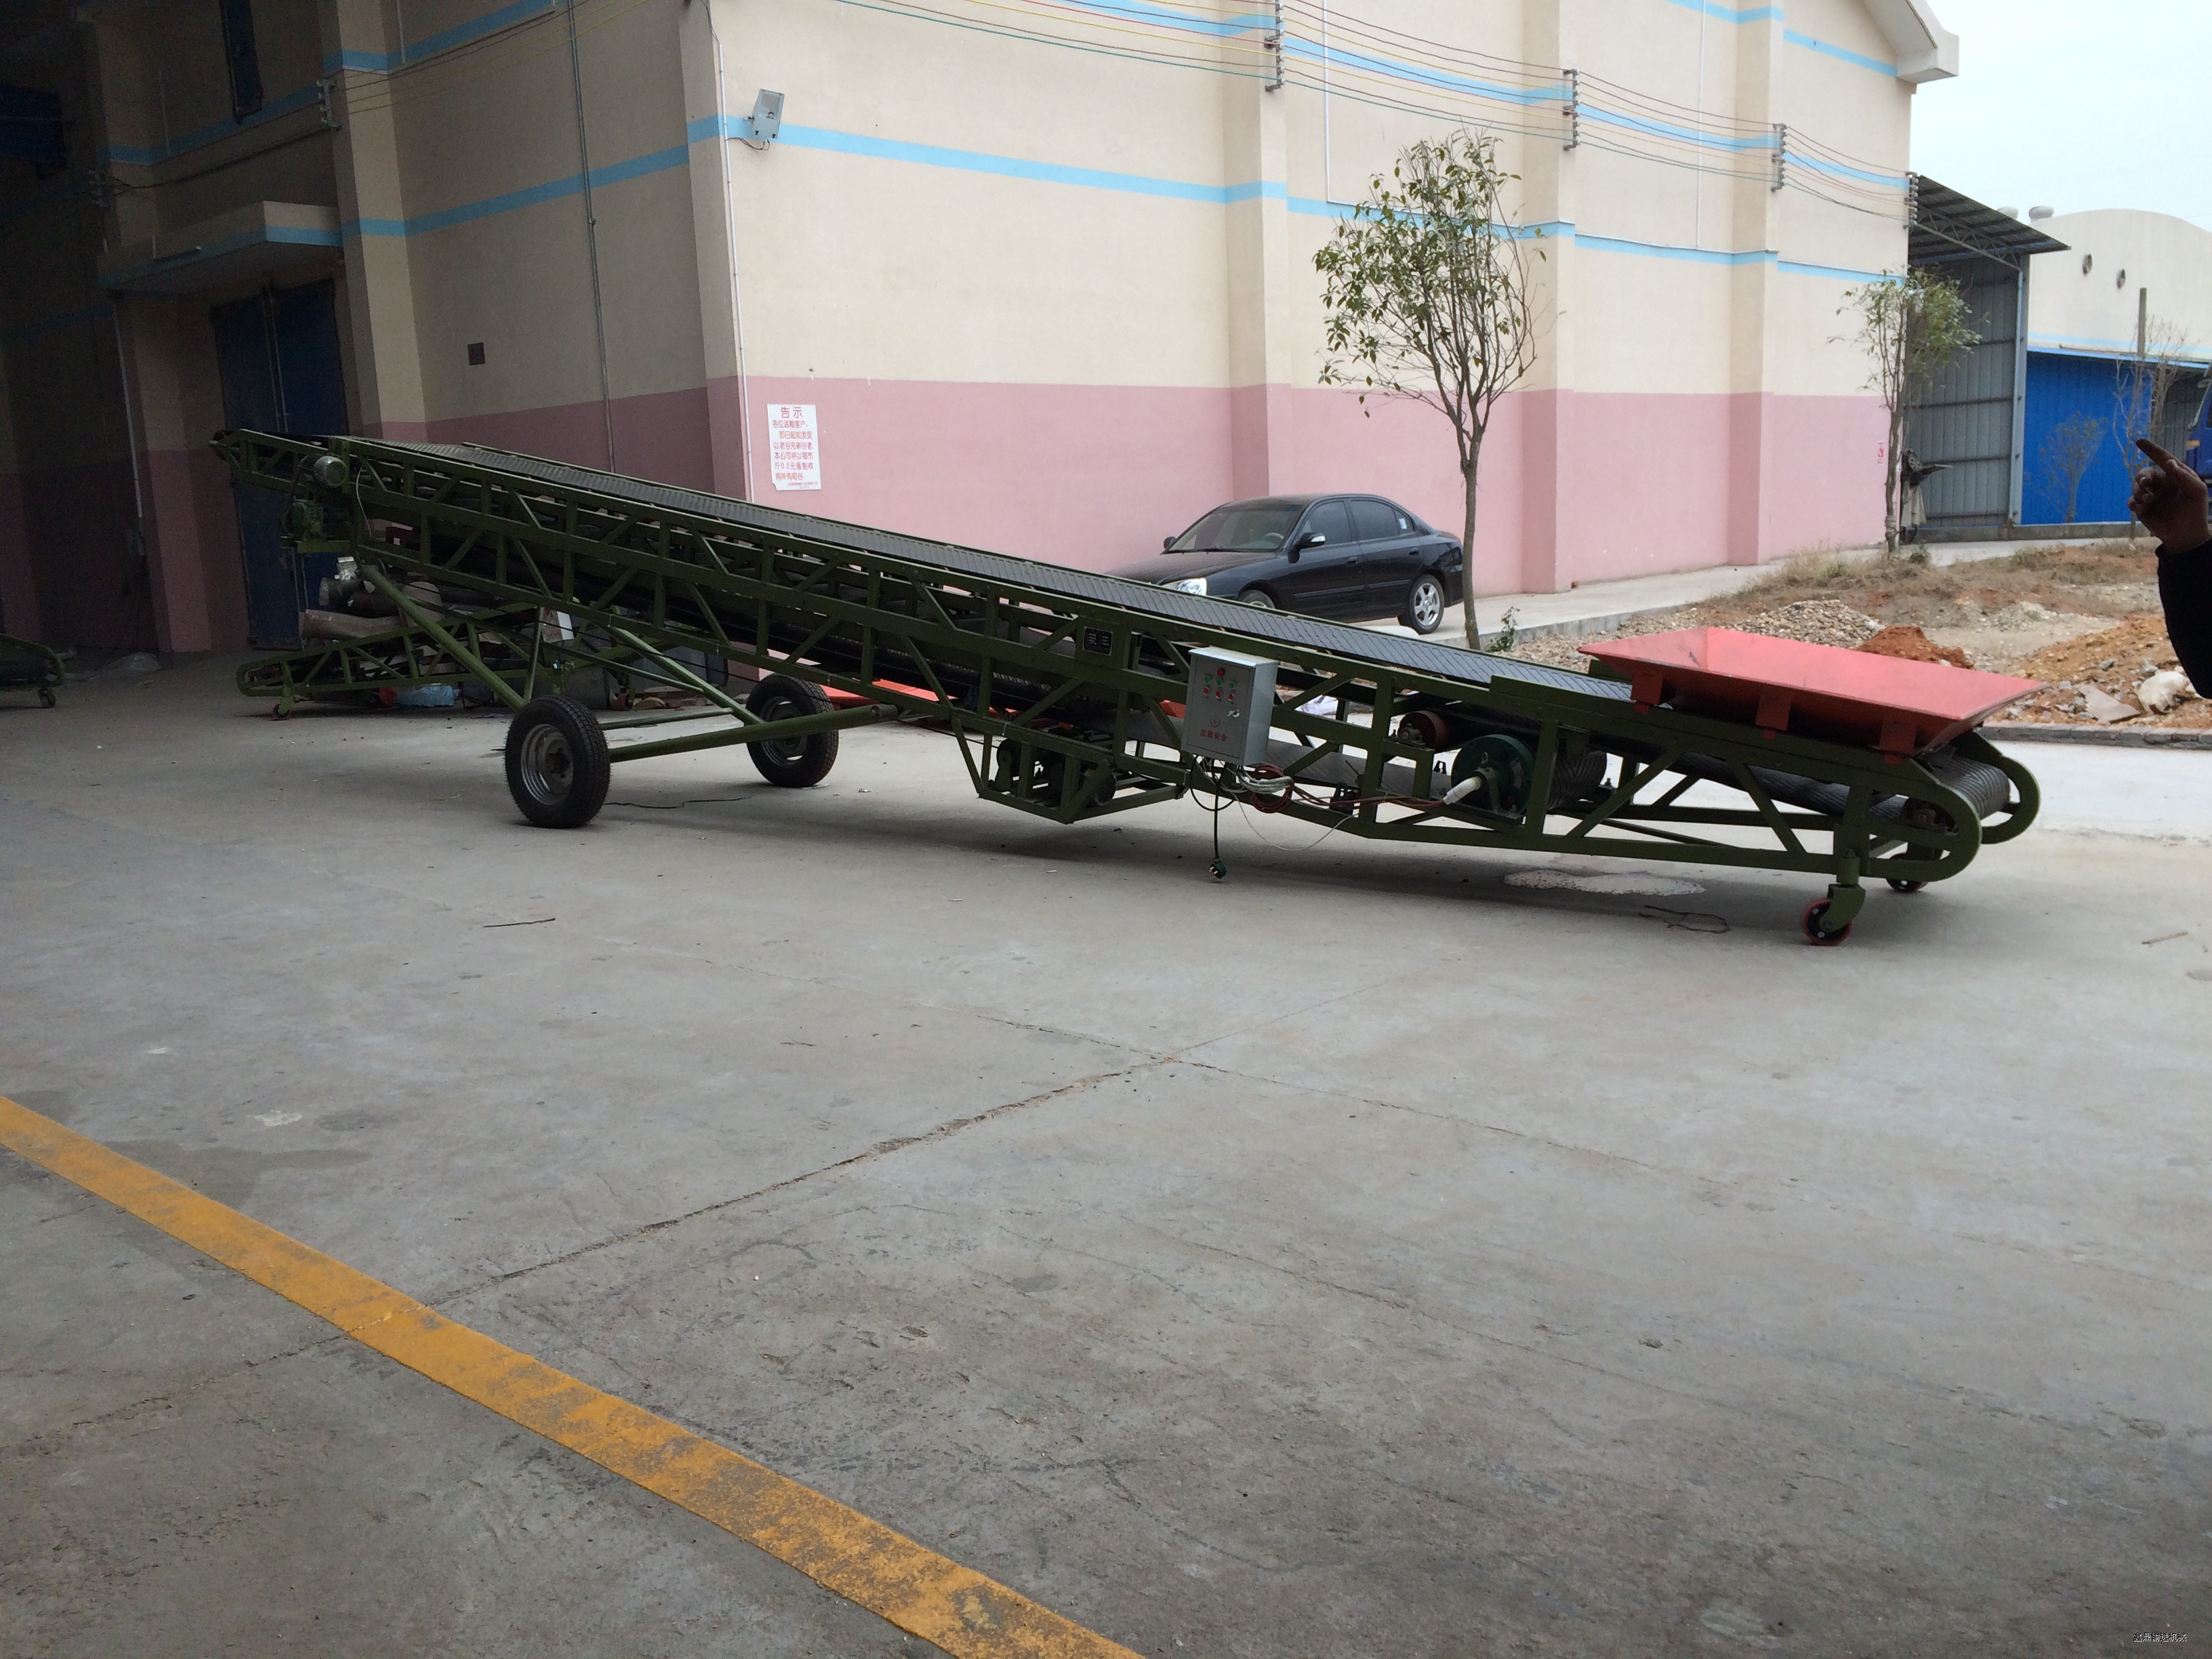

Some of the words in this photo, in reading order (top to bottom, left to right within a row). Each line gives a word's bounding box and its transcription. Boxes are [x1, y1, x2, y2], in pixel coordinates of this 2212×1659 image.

[780, 407, 803, 419] 告示
[1200, 729, 1227, 742] 注意安全
